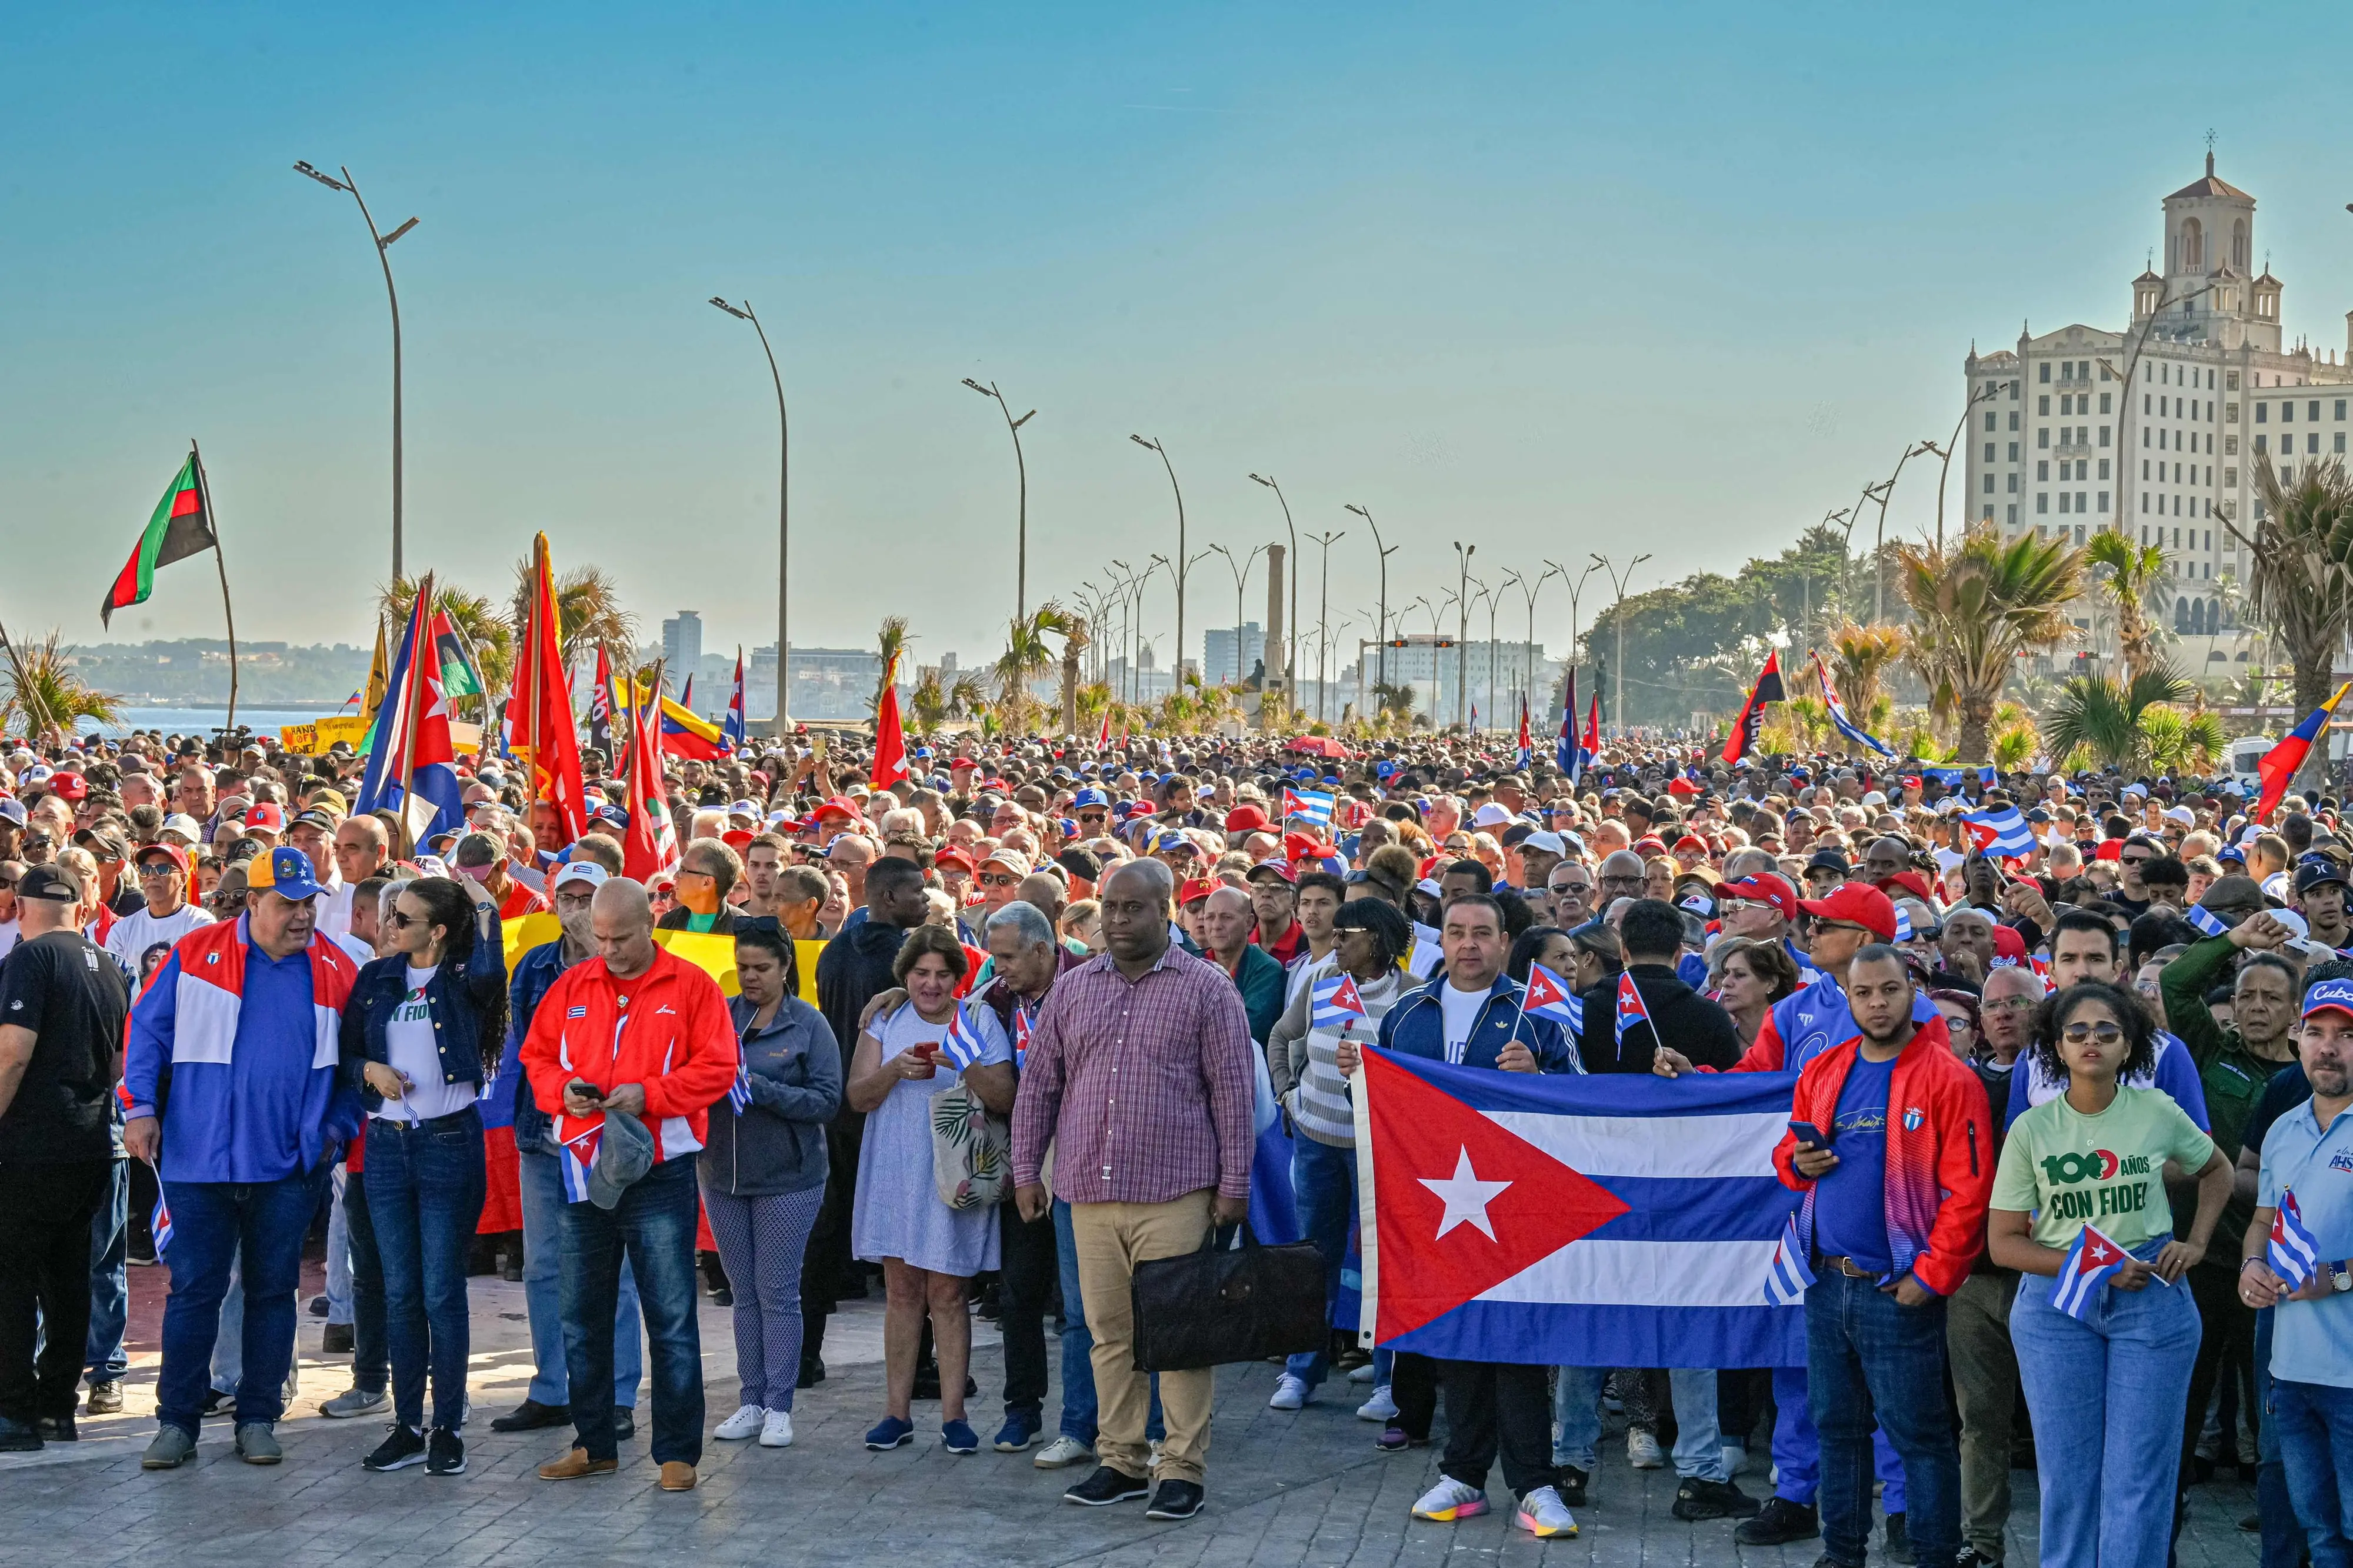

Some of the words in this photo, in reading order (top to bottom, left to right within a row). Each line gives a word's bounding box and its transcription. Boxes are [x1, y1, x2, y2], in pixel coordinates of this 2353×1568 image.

[2120, 1155, 2150, 1177] AÑOS
[2328, 1155, 2353, 1169] AHS
[2049, 1189, 2093, 1220] CON
